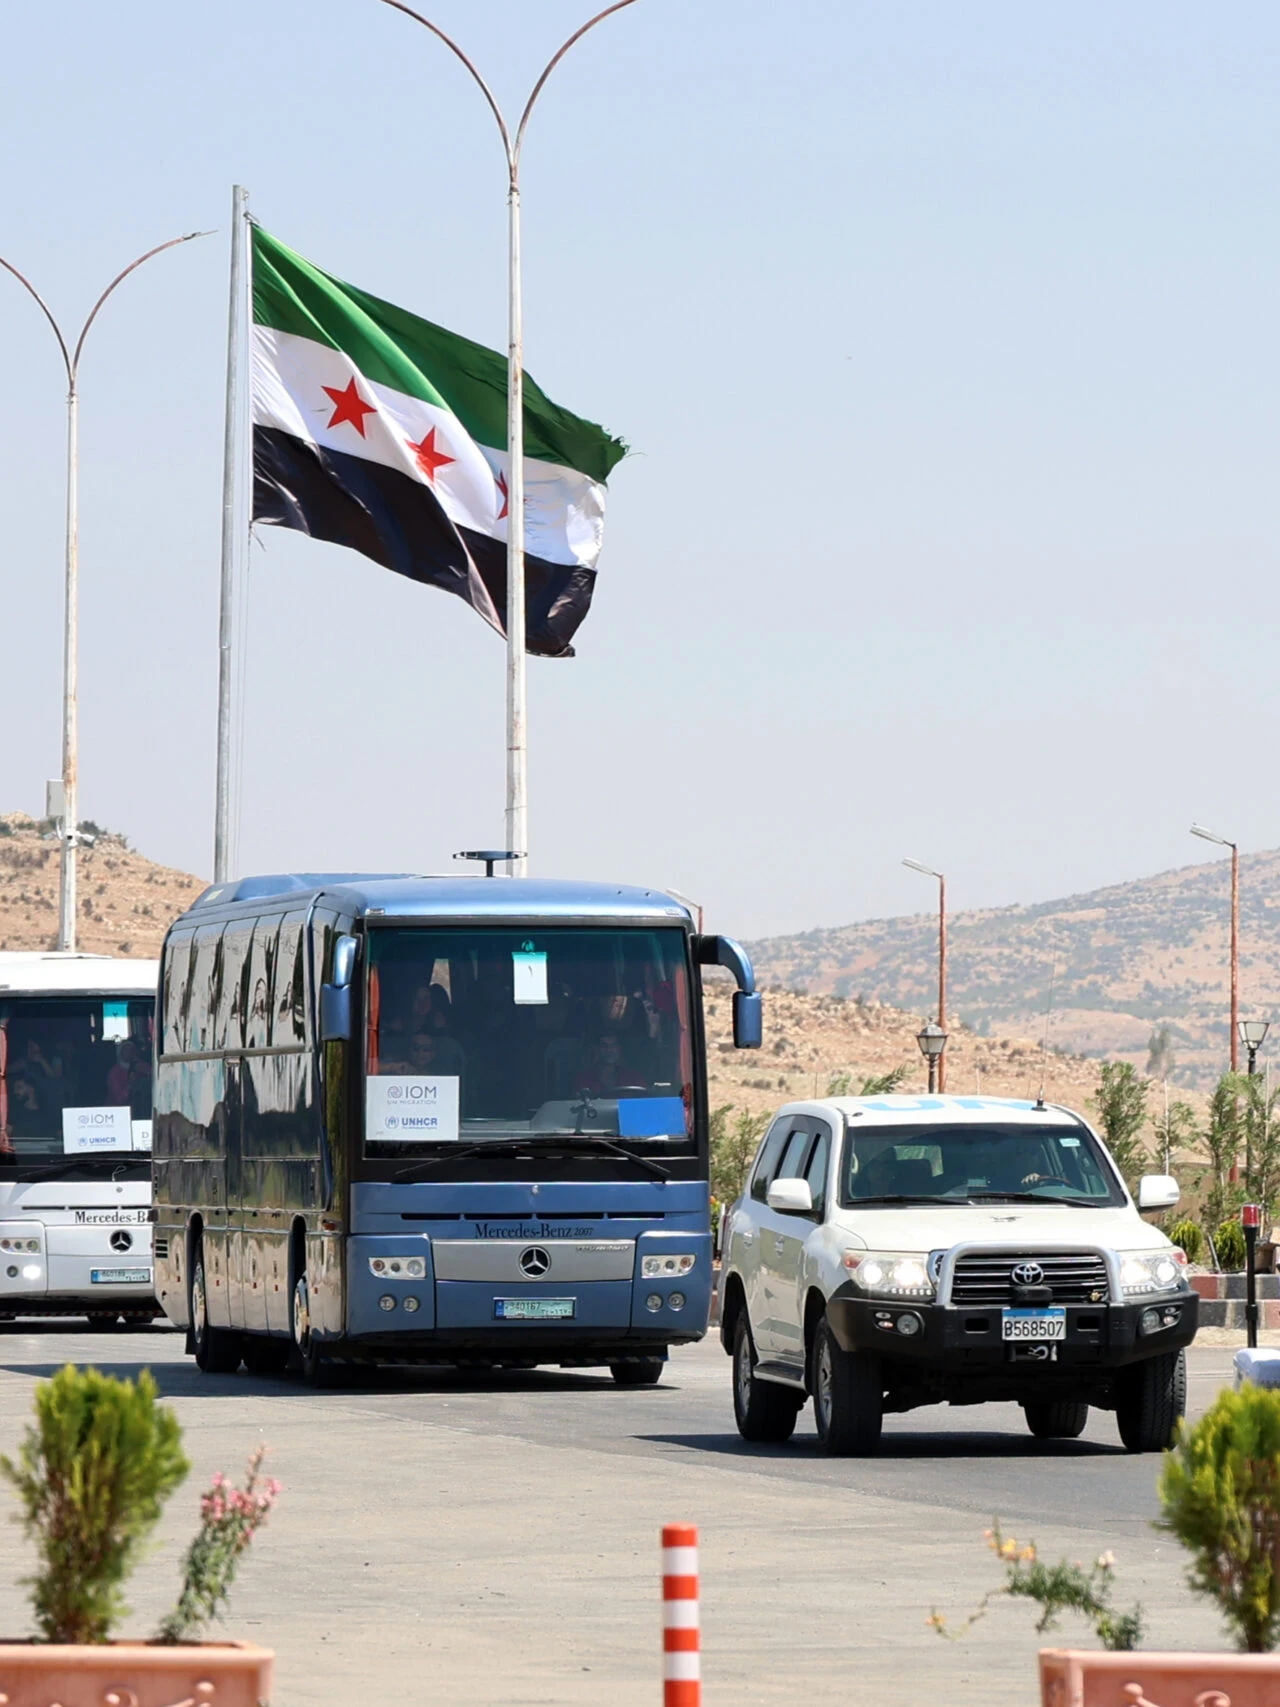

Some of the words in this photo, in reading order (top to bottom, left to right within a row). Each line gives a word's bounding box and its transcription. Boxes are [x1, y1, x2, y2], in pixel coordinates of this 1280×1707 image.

[405, 1085, 437, 1099] IOM
[90, 1113, 115, 1124] IOM
[401, 1117, 438, 1126] UNHCR
[89, 1136, 117, 1144] UNHCR
[75, 1210, 148, 1224] Mercedes-B
[474, 1223, 572, 1239] Mercedes-Benz
[573, 1227, 594, 1236] 2007
[1004, 1321, 1064, 1337] B568507
